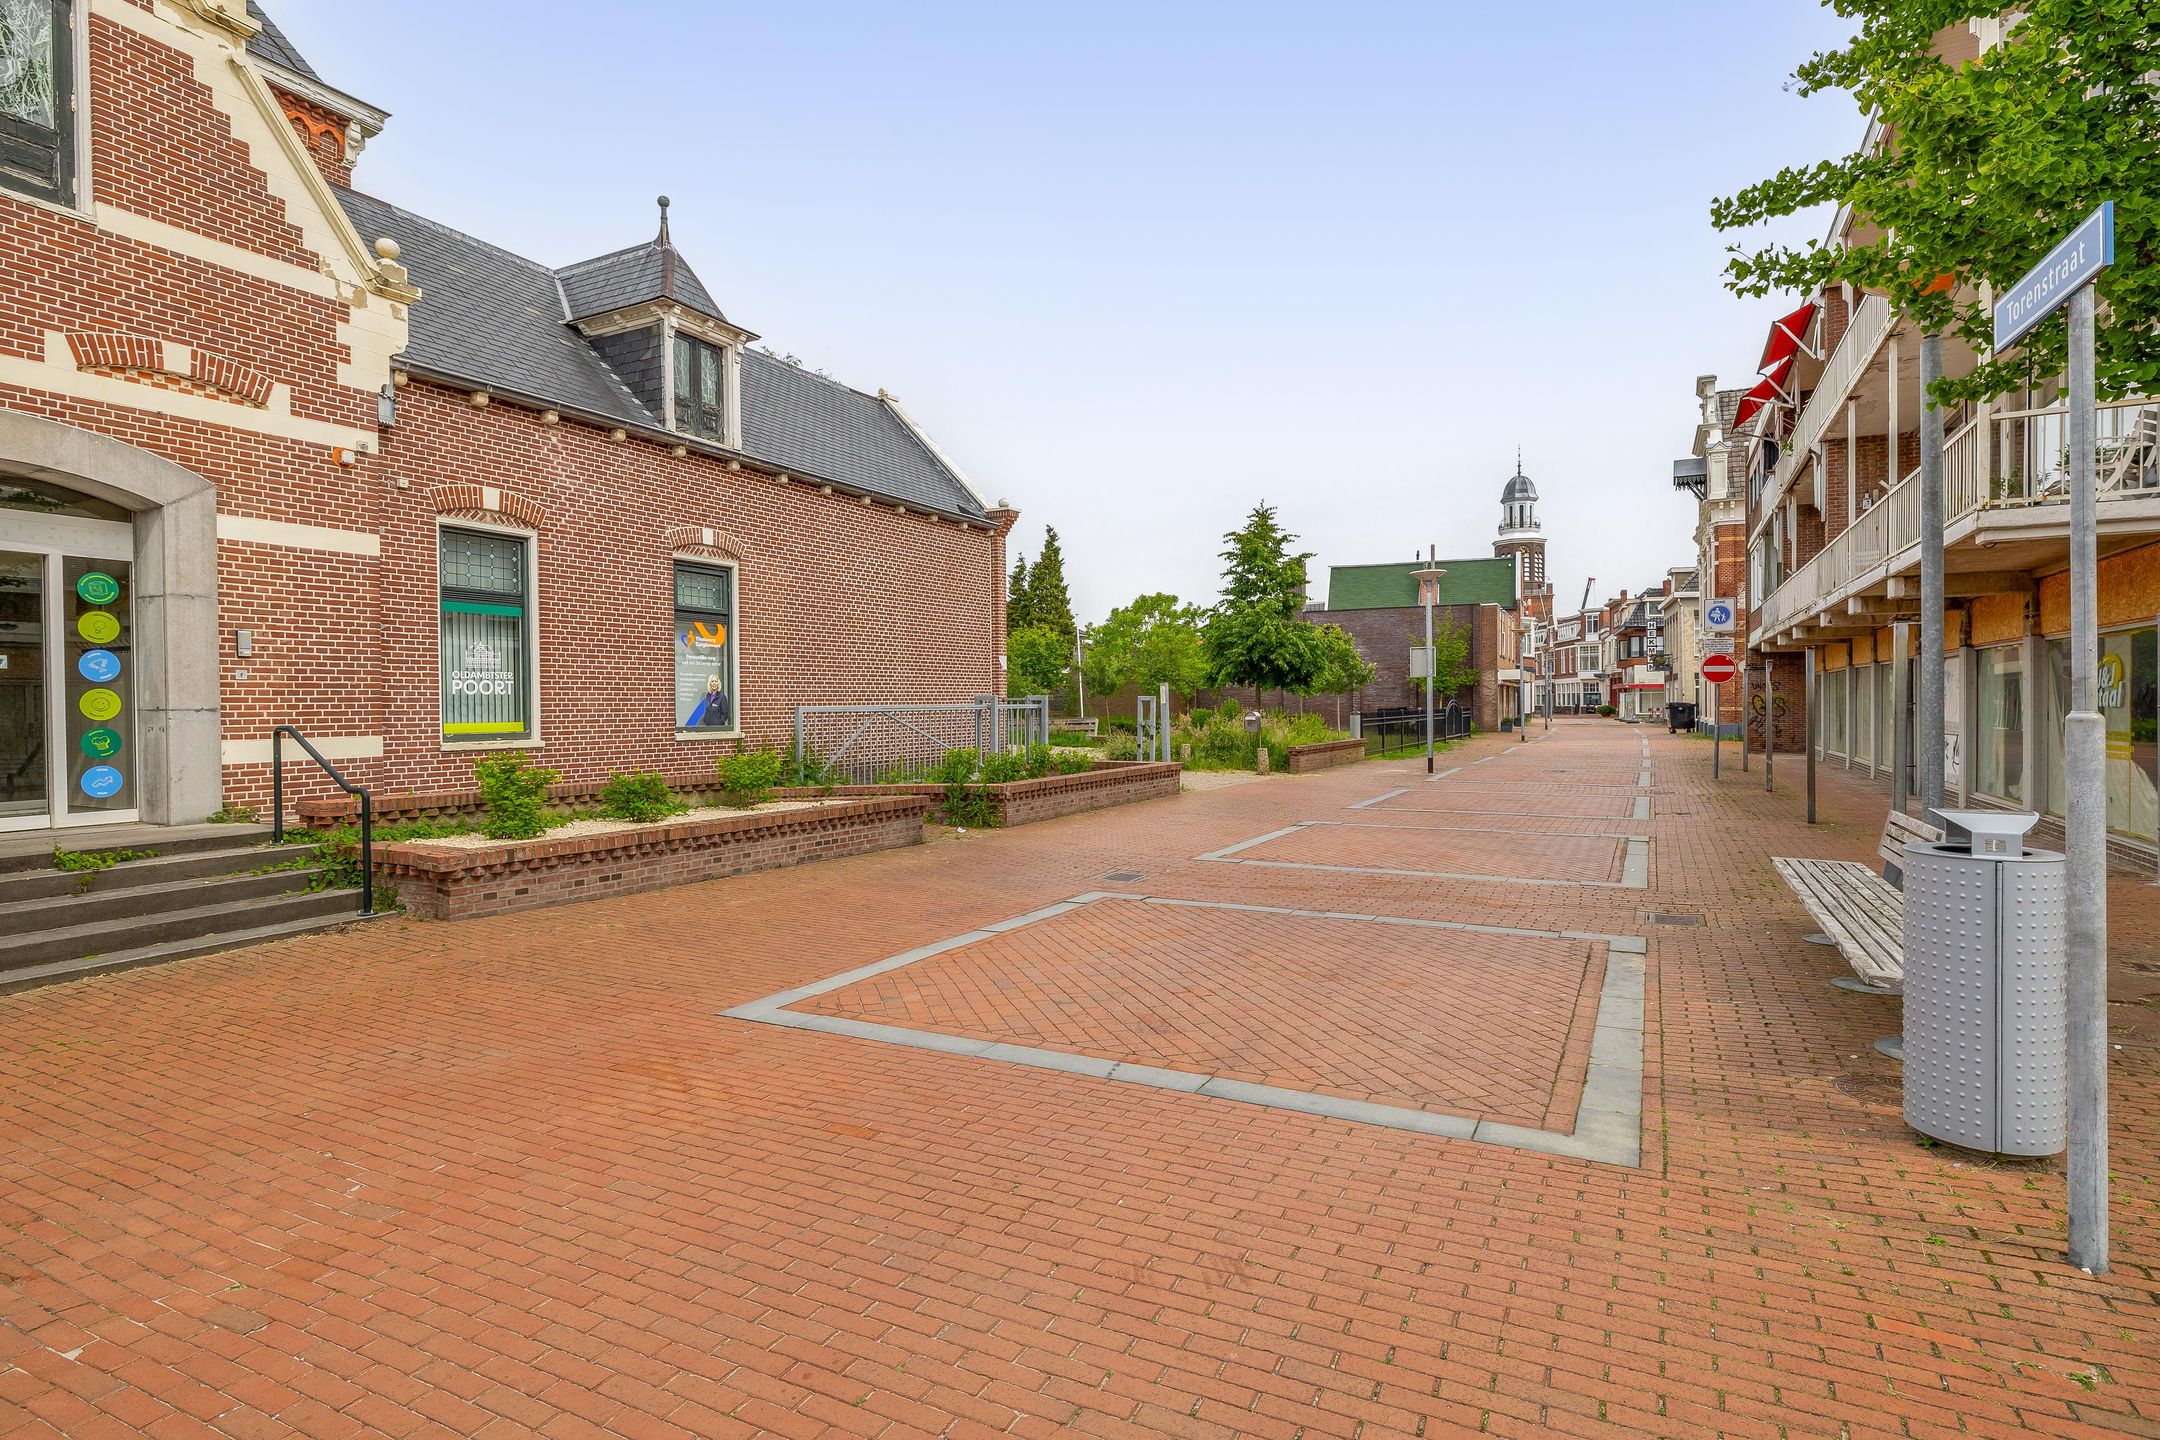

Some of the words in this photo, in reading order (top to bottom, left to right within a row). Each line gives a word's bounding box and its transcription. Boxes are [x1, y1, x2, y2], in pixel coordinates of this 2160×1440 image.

[2006, 240, 2086, 325] Torenstraat
[452, 671, 514, 679] OLDAMBTSTER
[452, 680, 514, 695] POORT
[2098, 680, 2122, 708] taal
